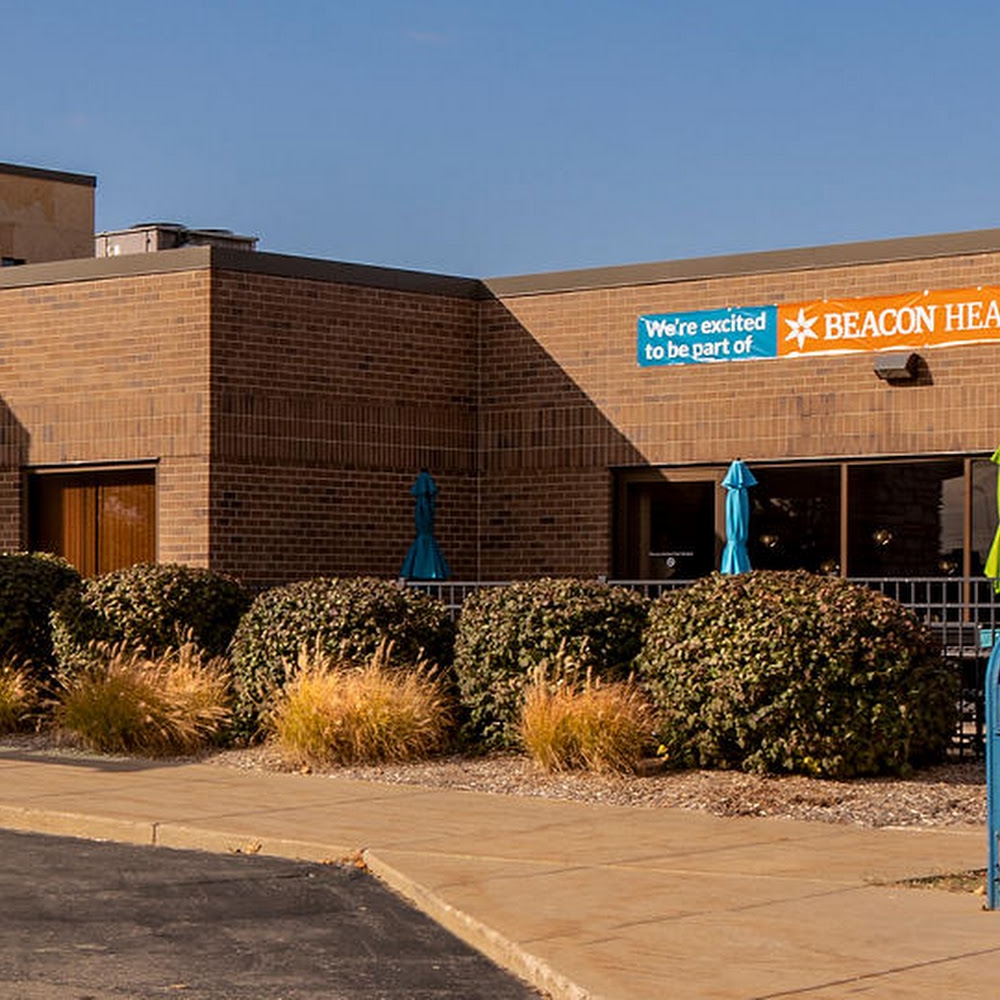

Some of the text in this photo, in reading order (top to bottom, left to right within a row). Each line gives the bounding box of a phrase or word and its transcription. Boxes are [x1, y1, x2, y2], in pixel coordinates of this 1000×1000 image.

[645, 311, 766, 337] We're excited
[824, 306, 936, 340] BEACON
[645, 335, 754, 360] to be part of
